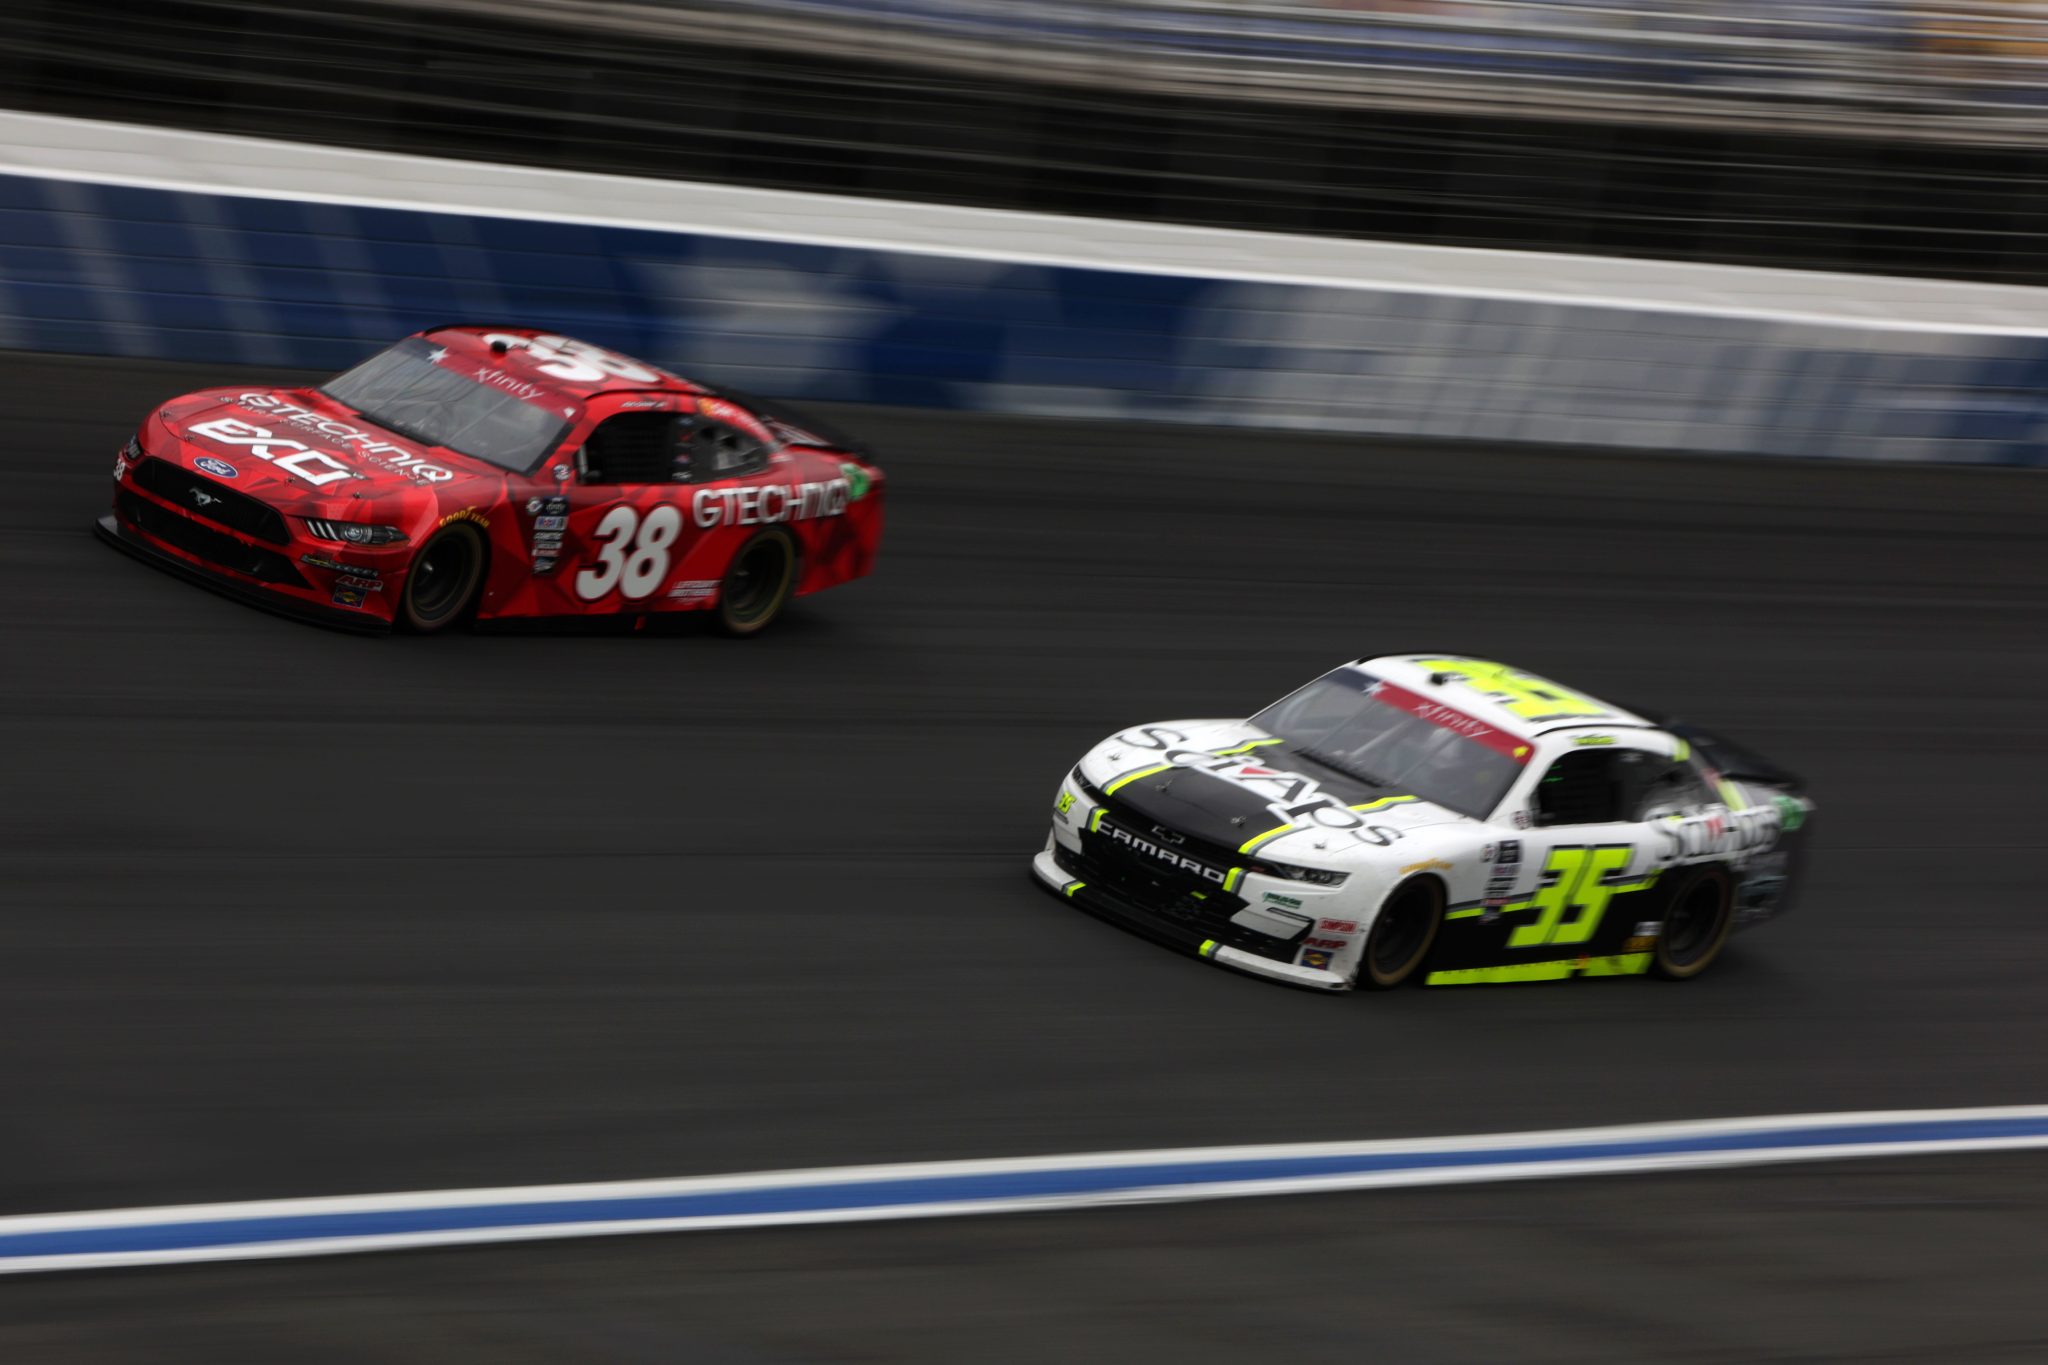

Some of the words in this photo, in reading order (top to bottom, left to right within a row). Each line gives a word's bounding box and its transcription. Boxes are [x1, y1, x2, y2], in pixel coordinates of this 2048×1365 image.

[473, 367, 544, 400] xfinity
[200, 459, 231, 474] Ford
[576, 506, 681, 599] 38
[1097, 821, 1227, 883] CAMARO
[1506, 847, 1632, 947] 35
